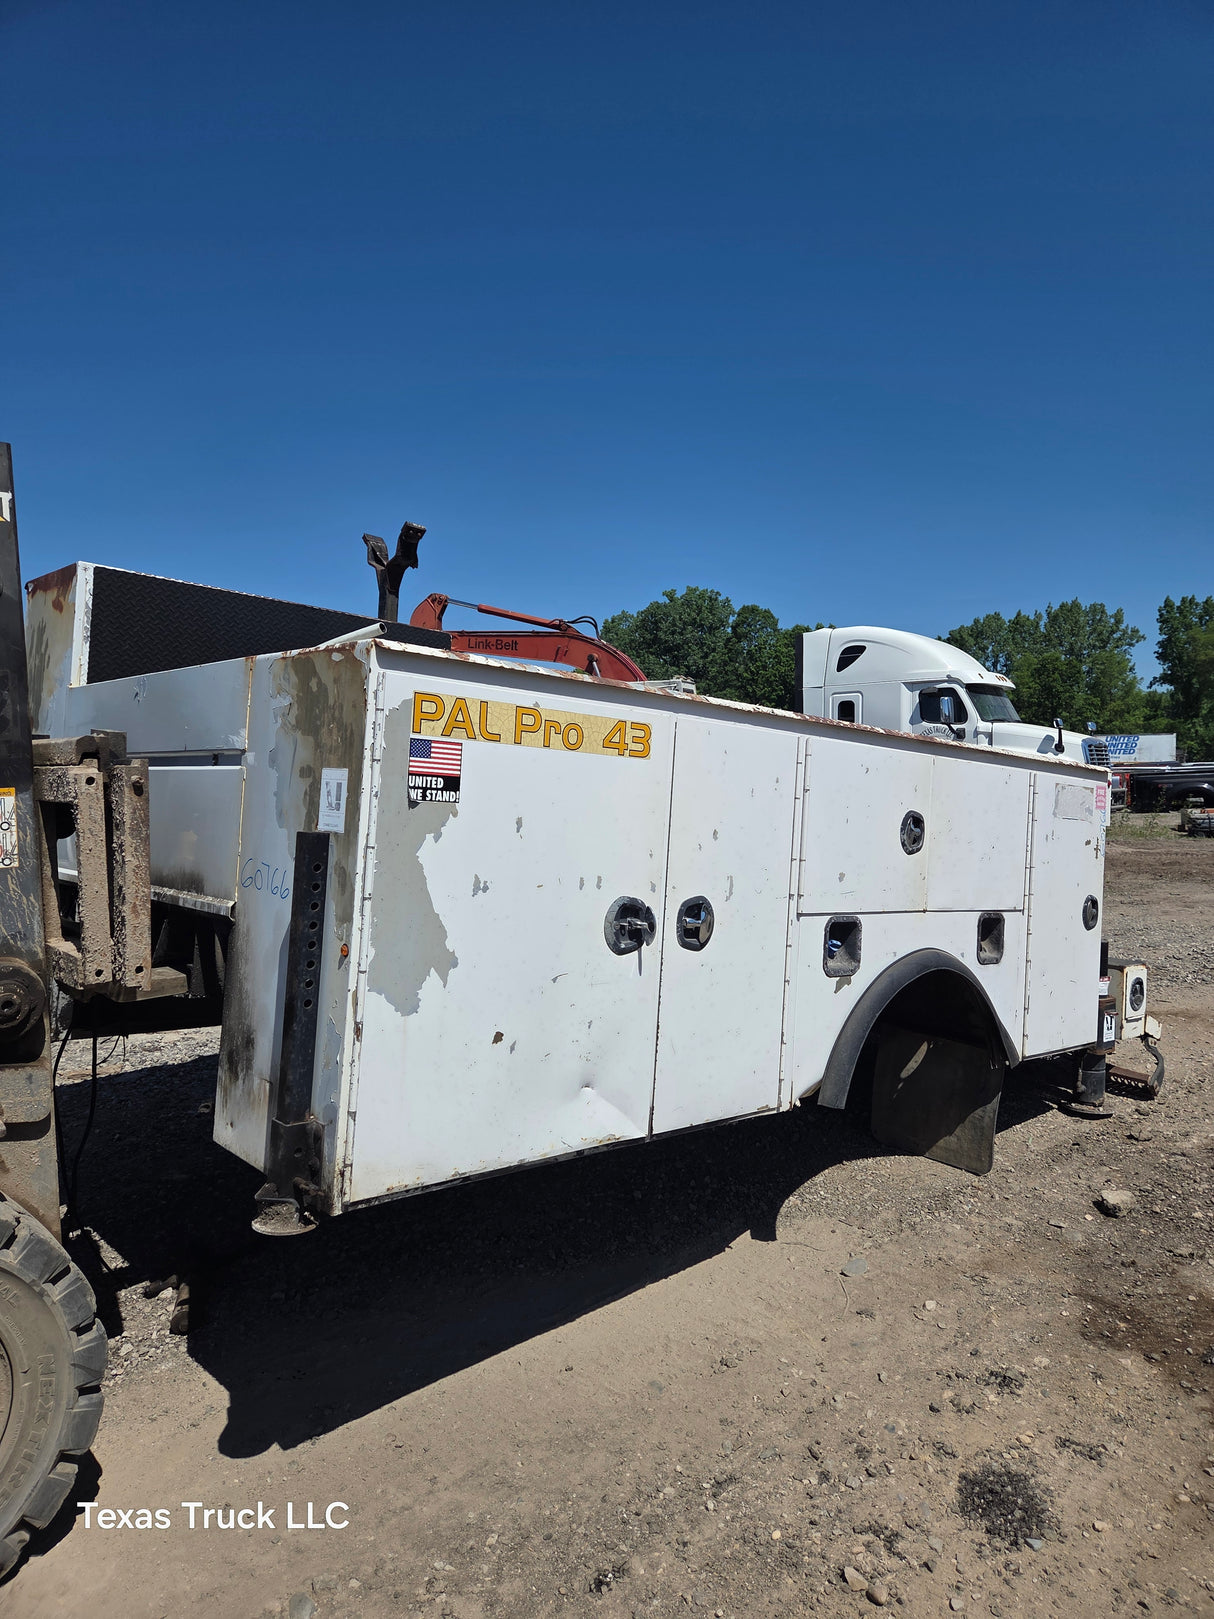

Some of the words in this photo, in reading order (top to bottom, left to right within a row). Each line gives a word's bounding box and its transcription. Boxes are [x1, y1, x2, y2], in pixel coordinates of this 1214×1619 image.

[468, 638, 519, 651] Link-Belt
[412, 692, 501, 742] PAL
[513, 706, 584, 750] Pro
[602, 720, 652, 758] 43
[408, 775, 444, 788] UNITED
[408, 788, 423, 800] WE
[425, 789, 460, 802] STAND!
[240, 857, 290, 900] 60766
